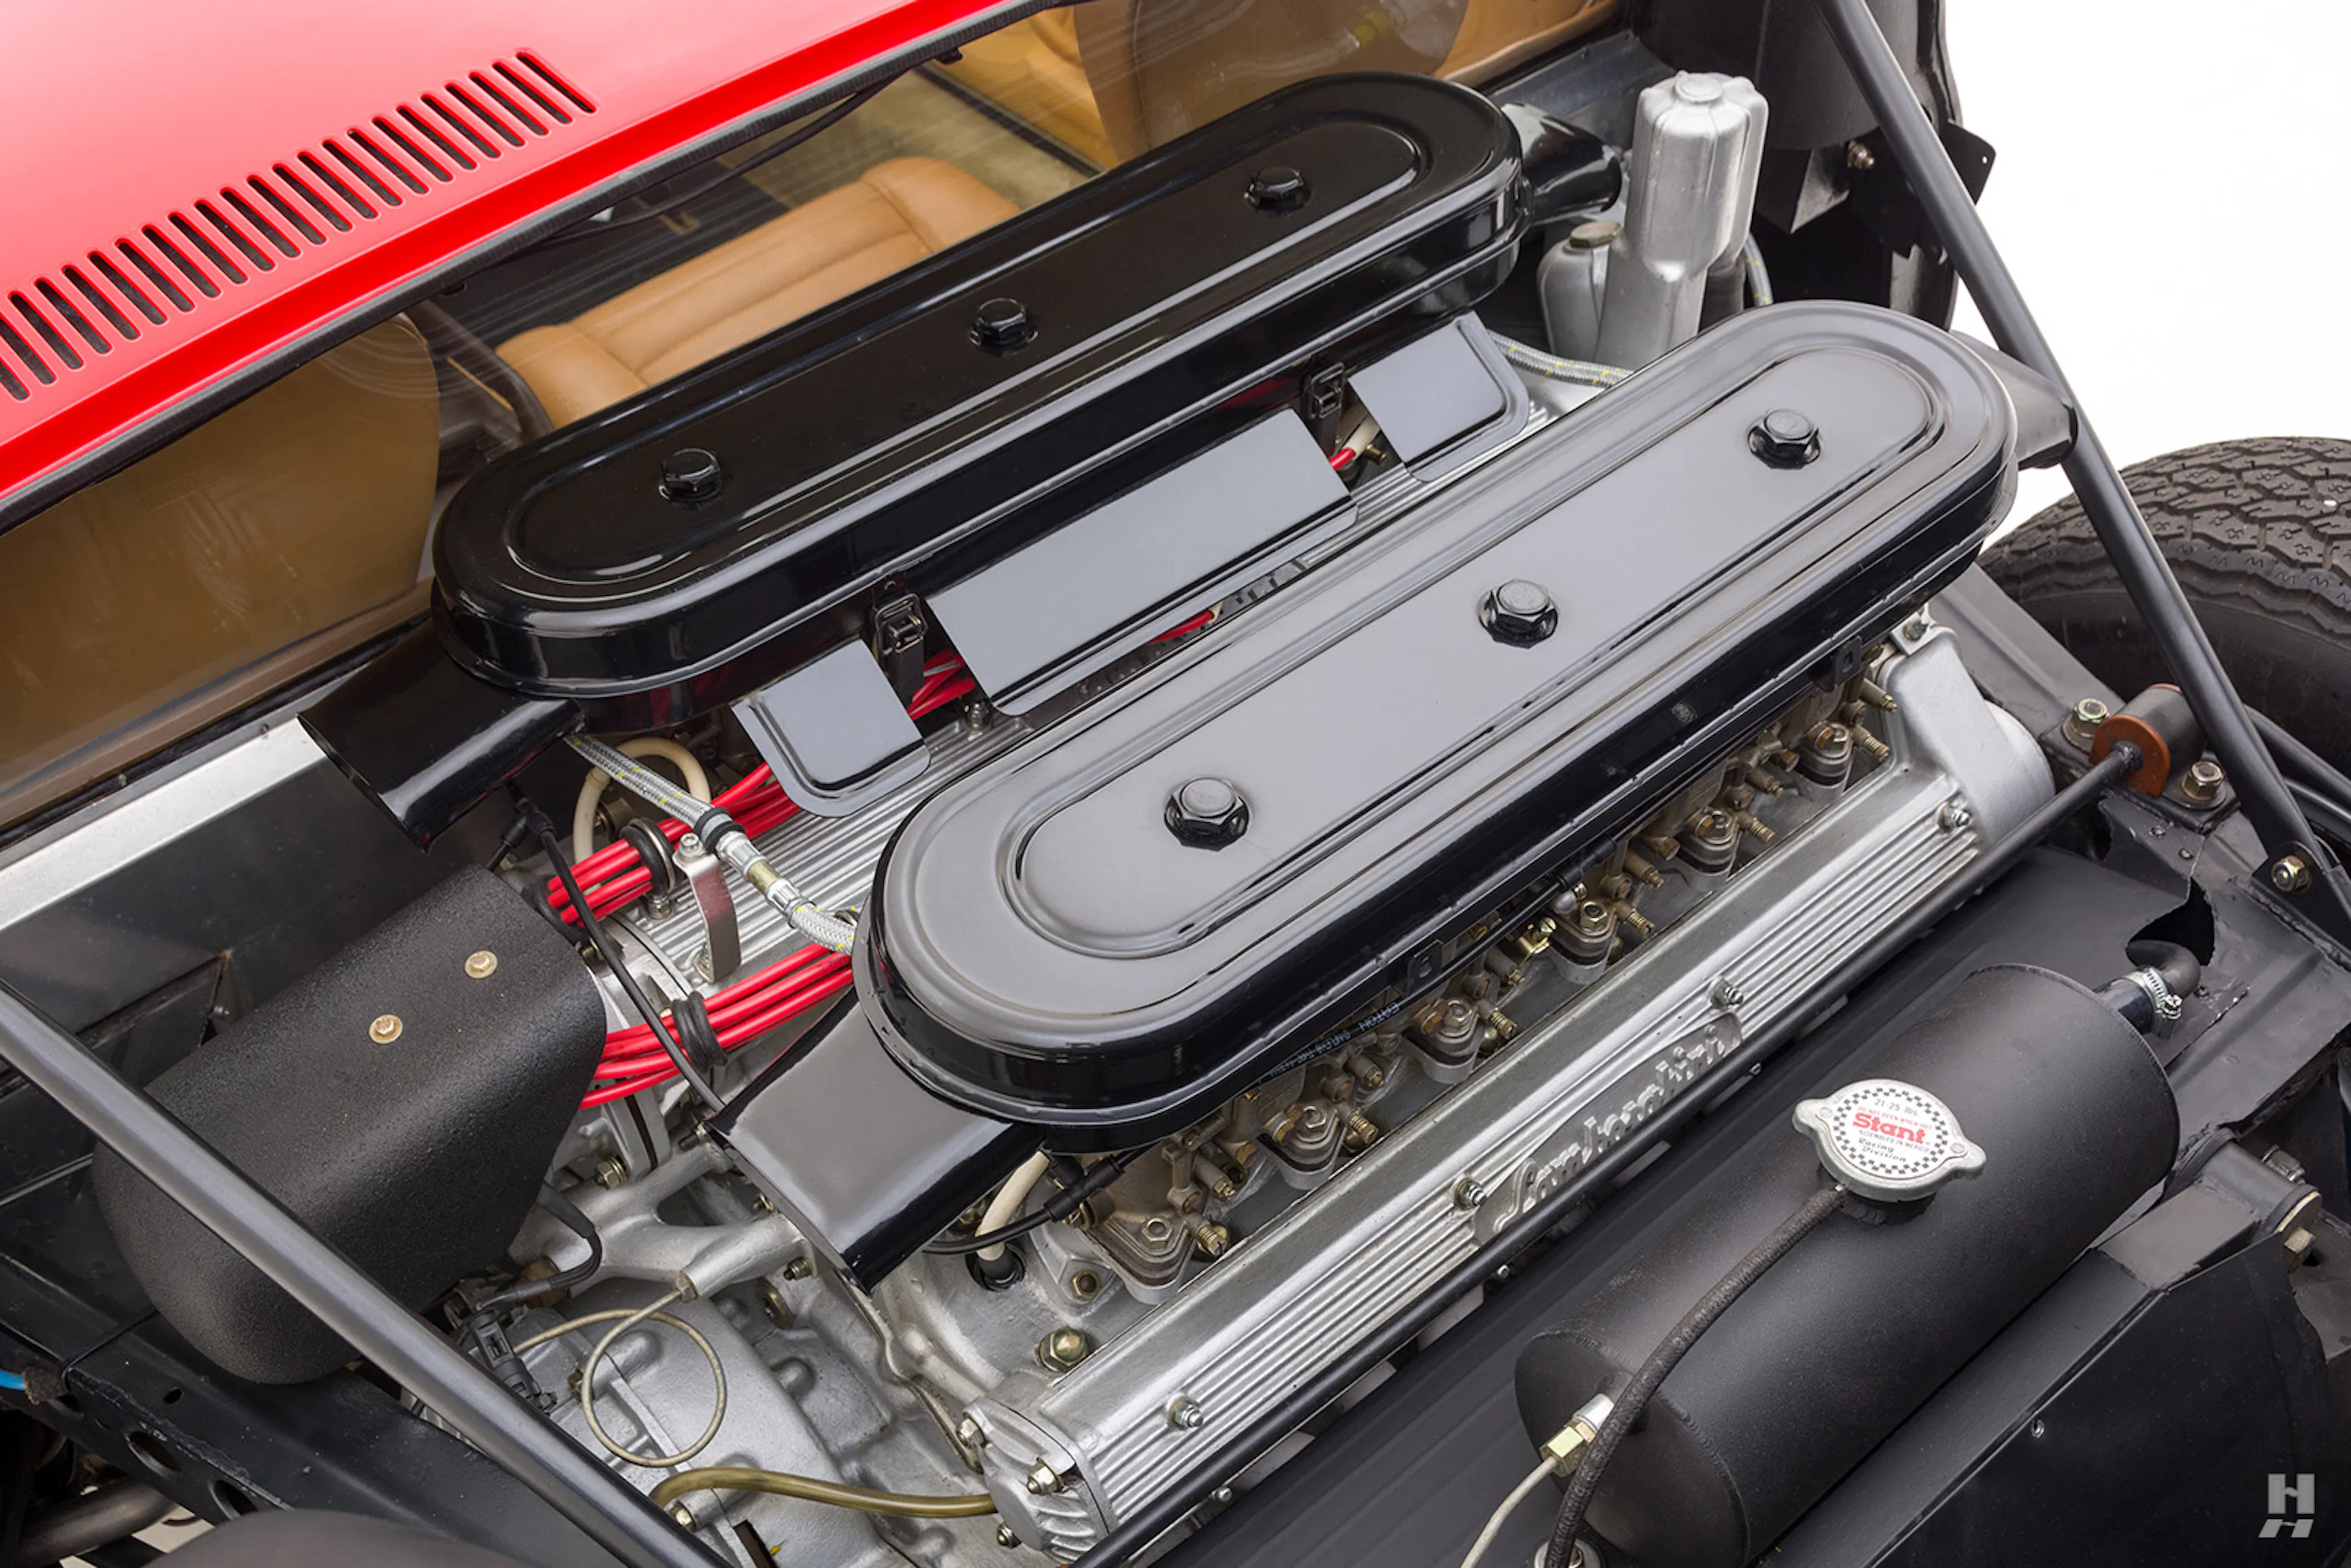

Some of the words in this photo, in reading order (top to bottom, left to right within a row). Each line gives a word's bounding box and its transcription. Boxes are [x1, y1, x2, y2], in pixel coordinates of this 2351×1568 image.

[1853, 1112, 1925, 1144] Stant
[1859, 1138, 1894, 1153] Racing
[1862, 1146, 1906, 1162] Division
